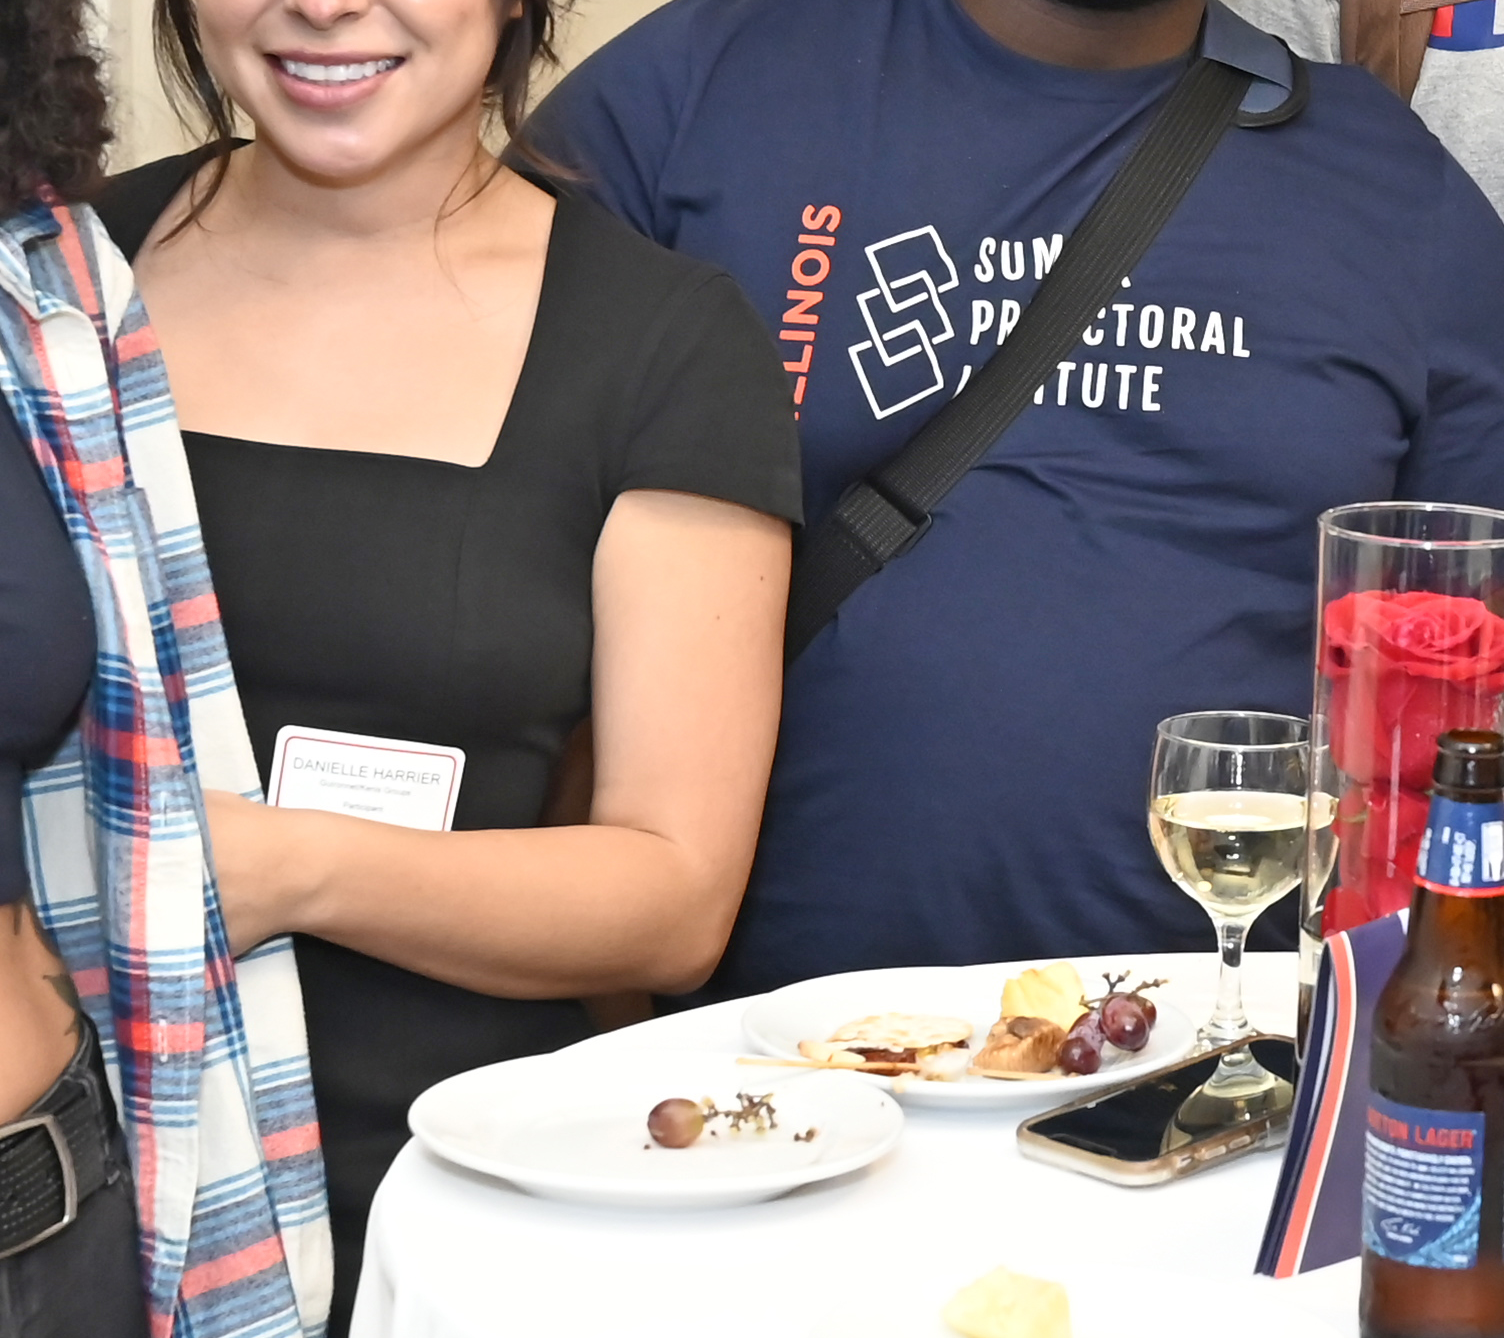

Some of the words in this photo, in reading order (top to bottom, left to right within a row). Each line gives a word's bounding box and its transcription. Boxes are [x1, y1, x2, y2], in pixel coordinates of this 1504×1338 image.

[779, 202, 842, 421] LINOIS
[969, 299, 1251, 359] PRCTORAL
[293, 756, 368, 778] DANIELLE
[373, 766, 441, 786] HARRIER
[1415, 1125, 1474, 1149] LAGER
